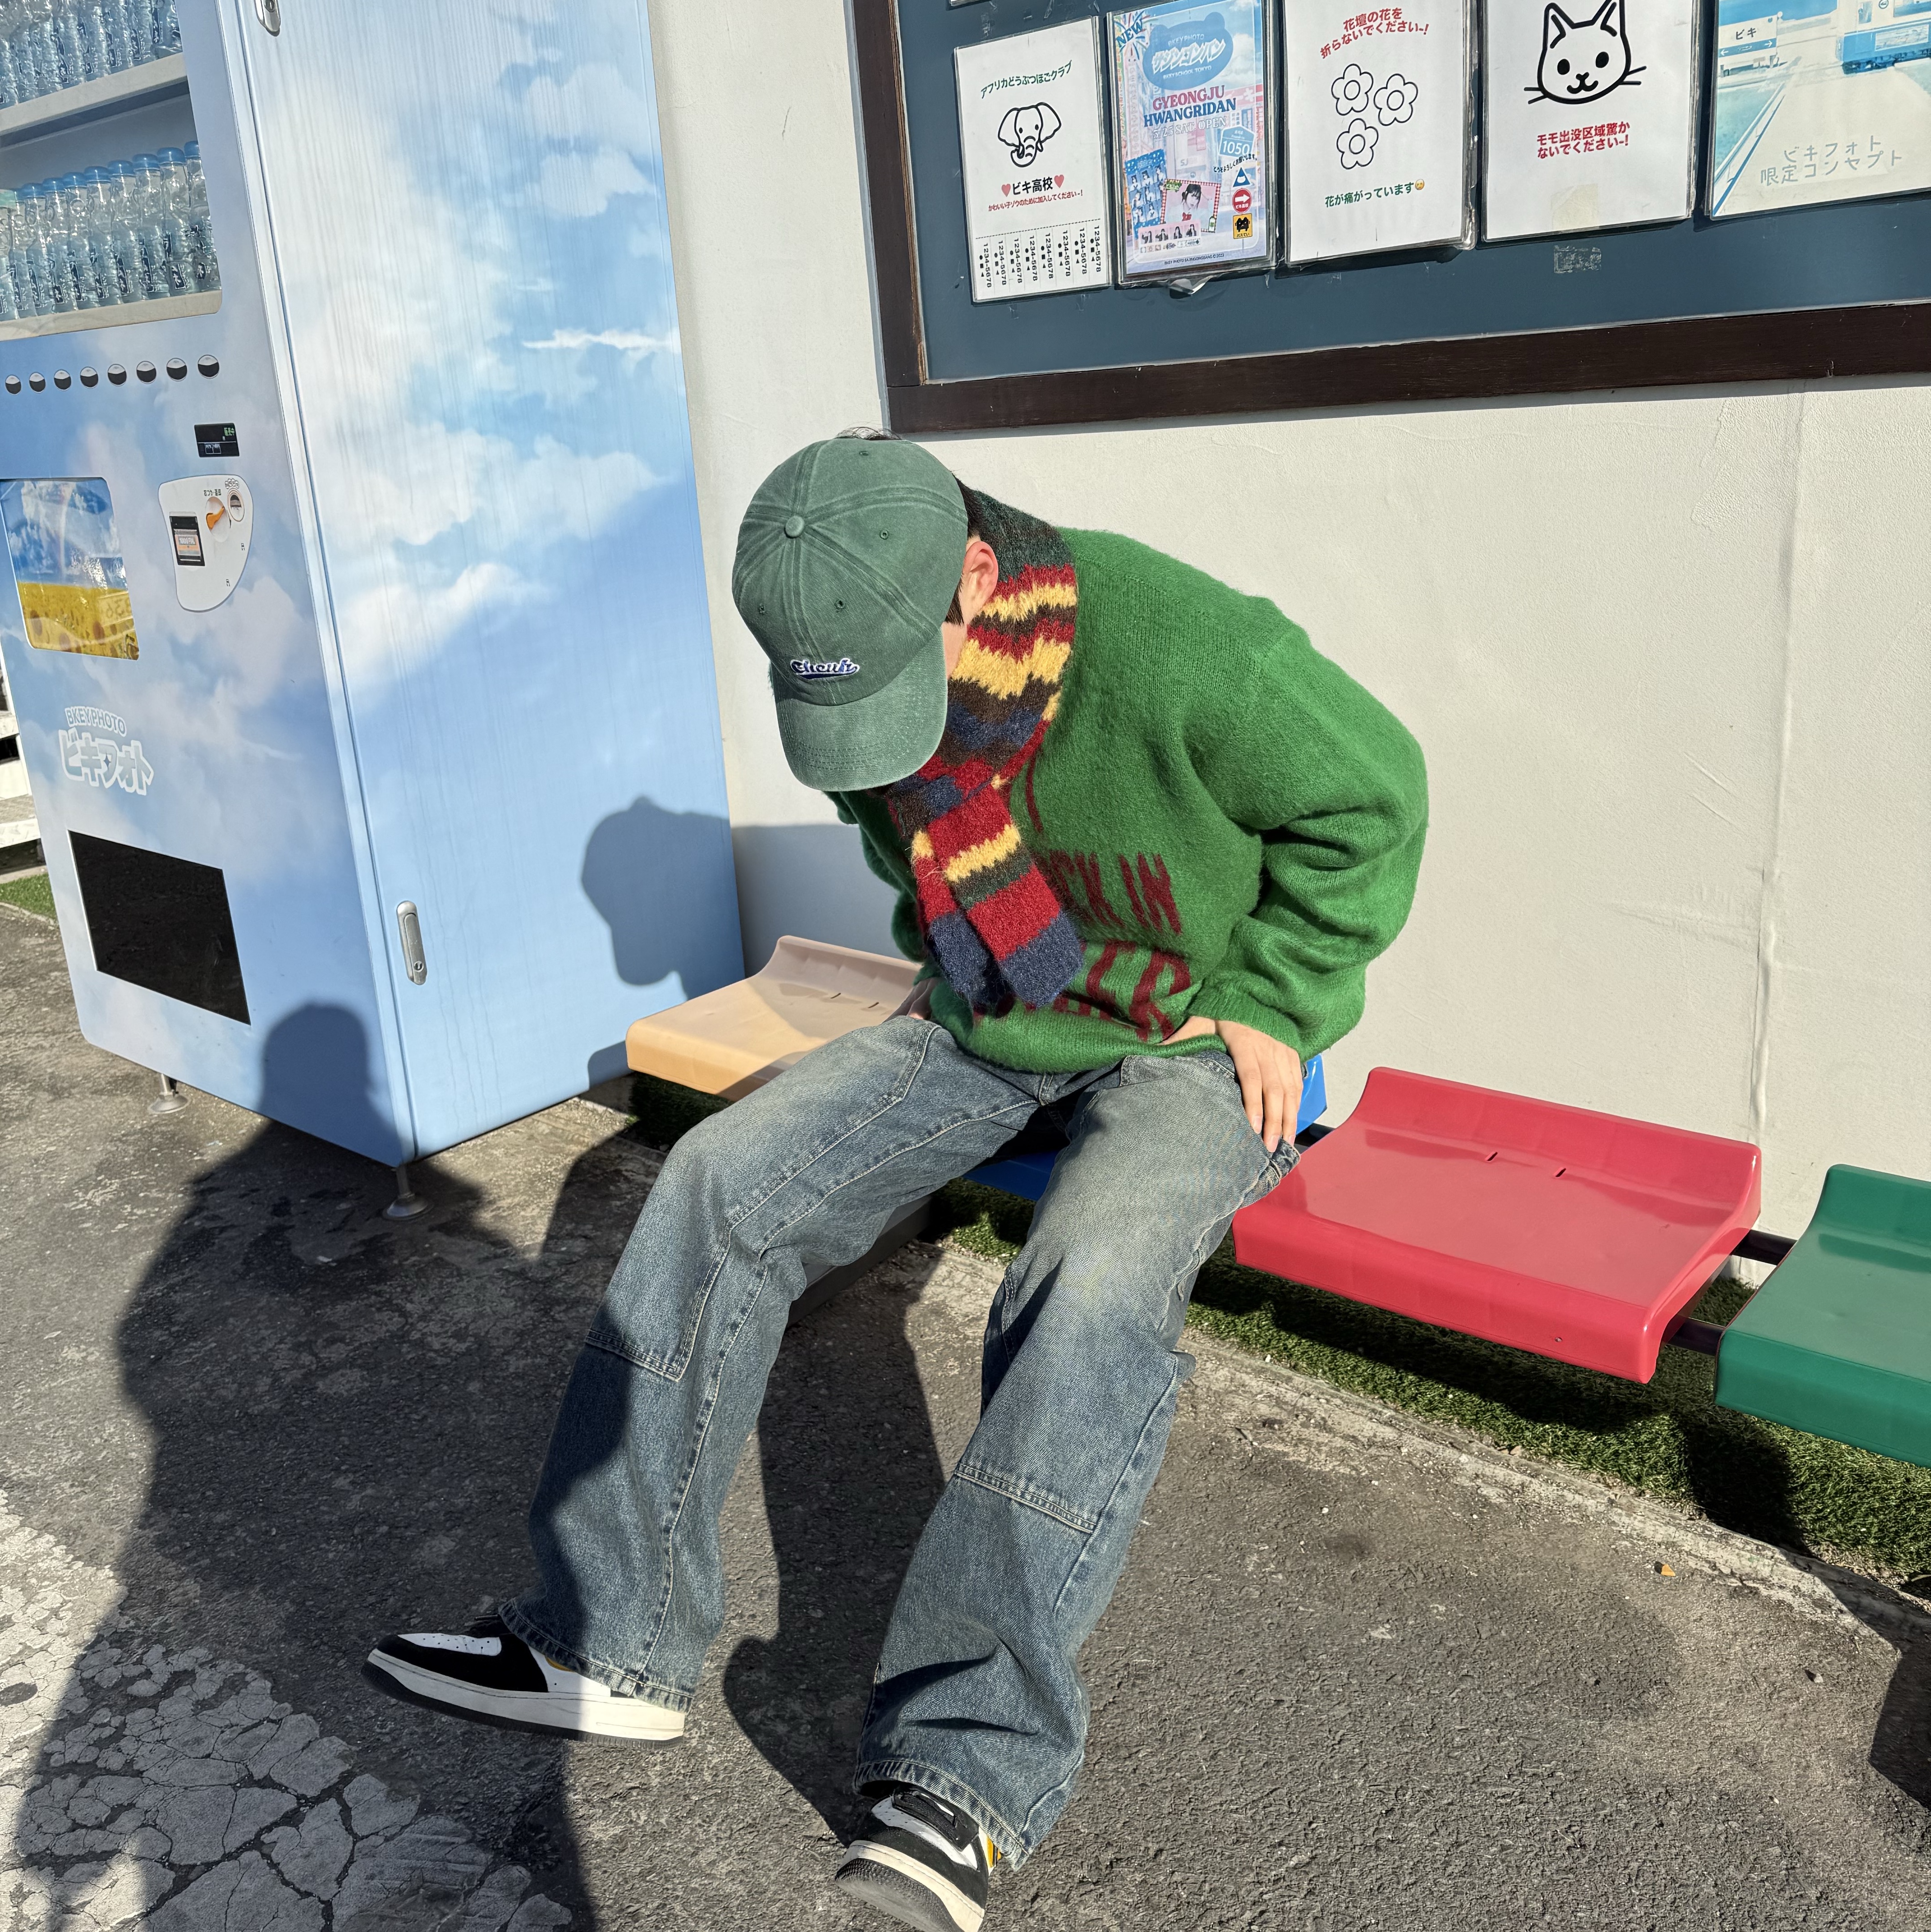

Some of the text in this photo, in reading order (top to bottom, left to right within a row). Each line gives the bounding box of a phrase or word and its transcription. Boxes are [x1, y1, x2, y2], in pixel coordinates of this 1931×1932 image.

[1343, 7, 1403, 32] 花壇の花を
[1115, 18, 1143, 48] NEW
[1736, 27, 1757, 40] ビキ
[981, 60, 1072, 99] アフリカどうぶつほごクラブ
[1152, 85, 1225, 111] GYEONGJU
[1143, 98, 1236, 127] HWANGRIDAN
[1197, 116, 1227, 130] OPEN
[1537, 121, 1630, 146] モモ出没区域驚か
[1223, 140, 1250, 156] 1050
[1784, 135, 1881, 163] ビキフォト
[1760, 150, 1902, 186] 限定コンセプト
[1013, 176, 1053, 195] ビキ高校
[1325, 182, 1414, 208] 花が痛がっています
[65, 706, 127, 737] BKEYPHOTO
[59, 727, 154, 796] ビキフォト
